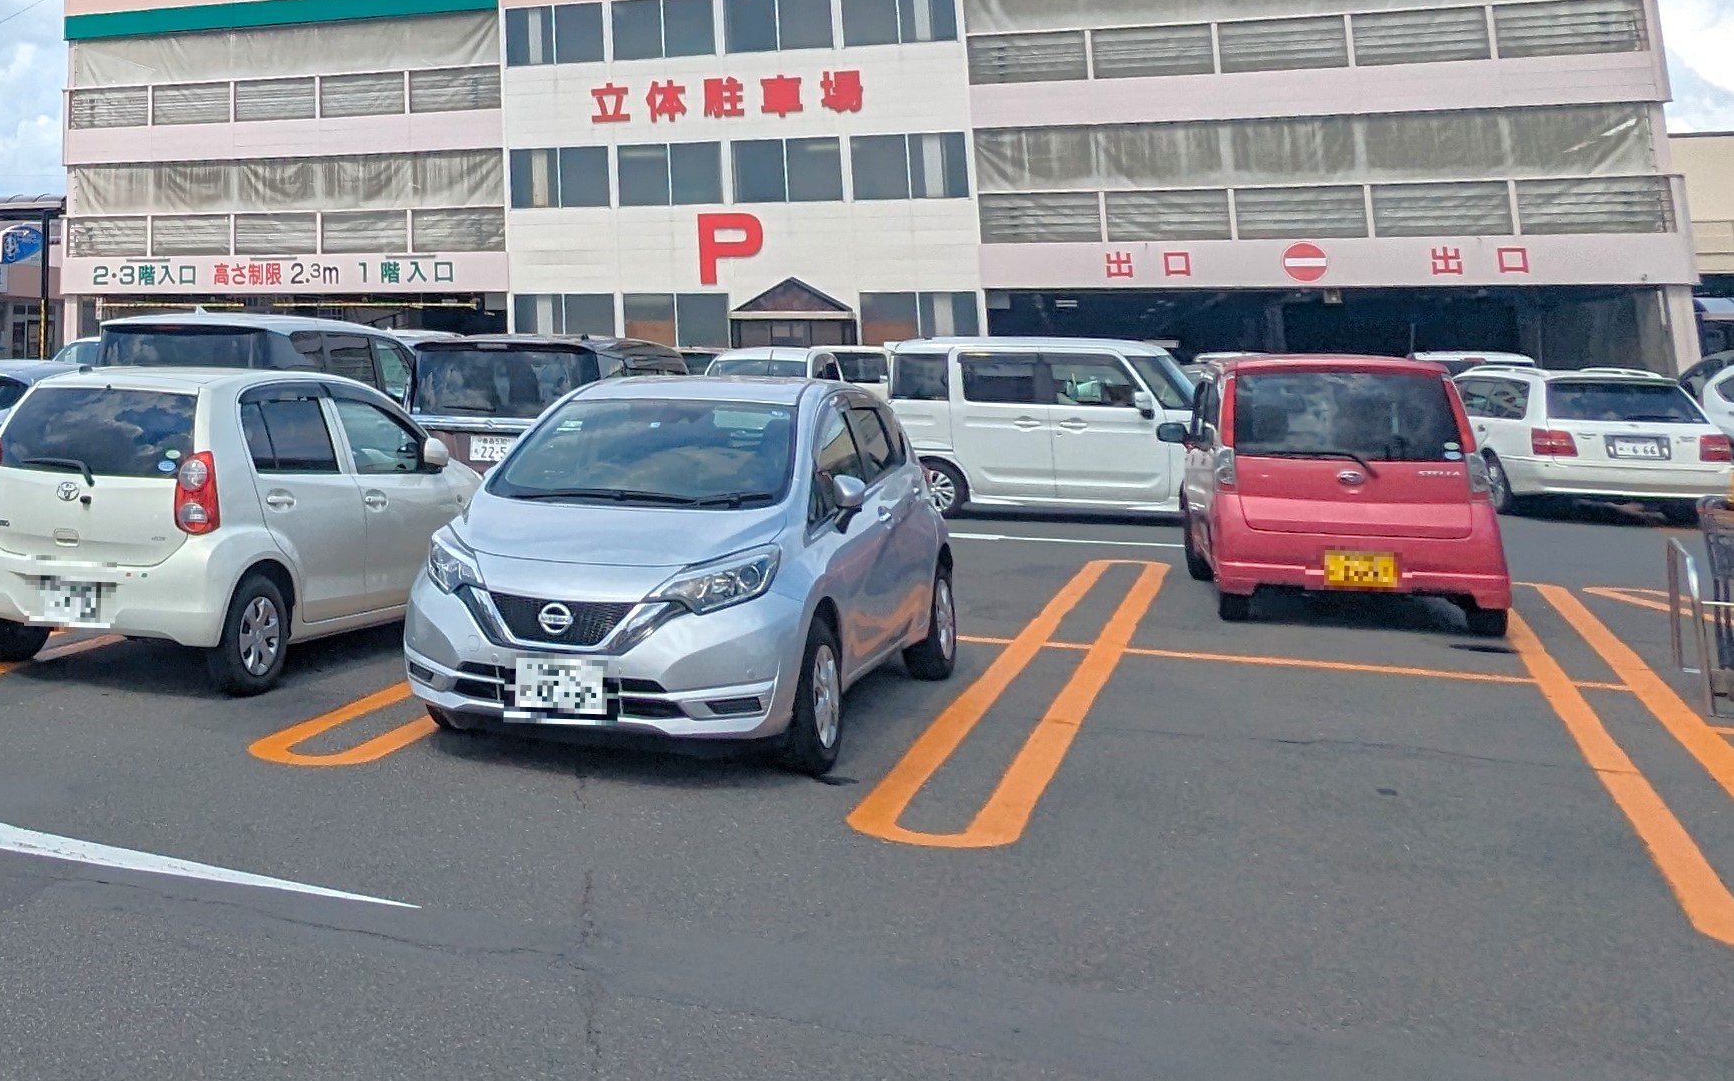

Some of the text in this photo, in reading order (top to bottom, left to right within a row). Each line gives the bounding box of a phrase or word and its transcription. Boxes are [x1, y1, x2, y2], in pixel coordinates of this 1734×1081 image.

[591, 70, 863, 123] 立体駐車場
[697, 212, 764, 285] P
[1431, 246, 1529, 276] 出口
[213, 262, 282, 286] 高さ制限
[1106, 251, 1191, 278] 出口
